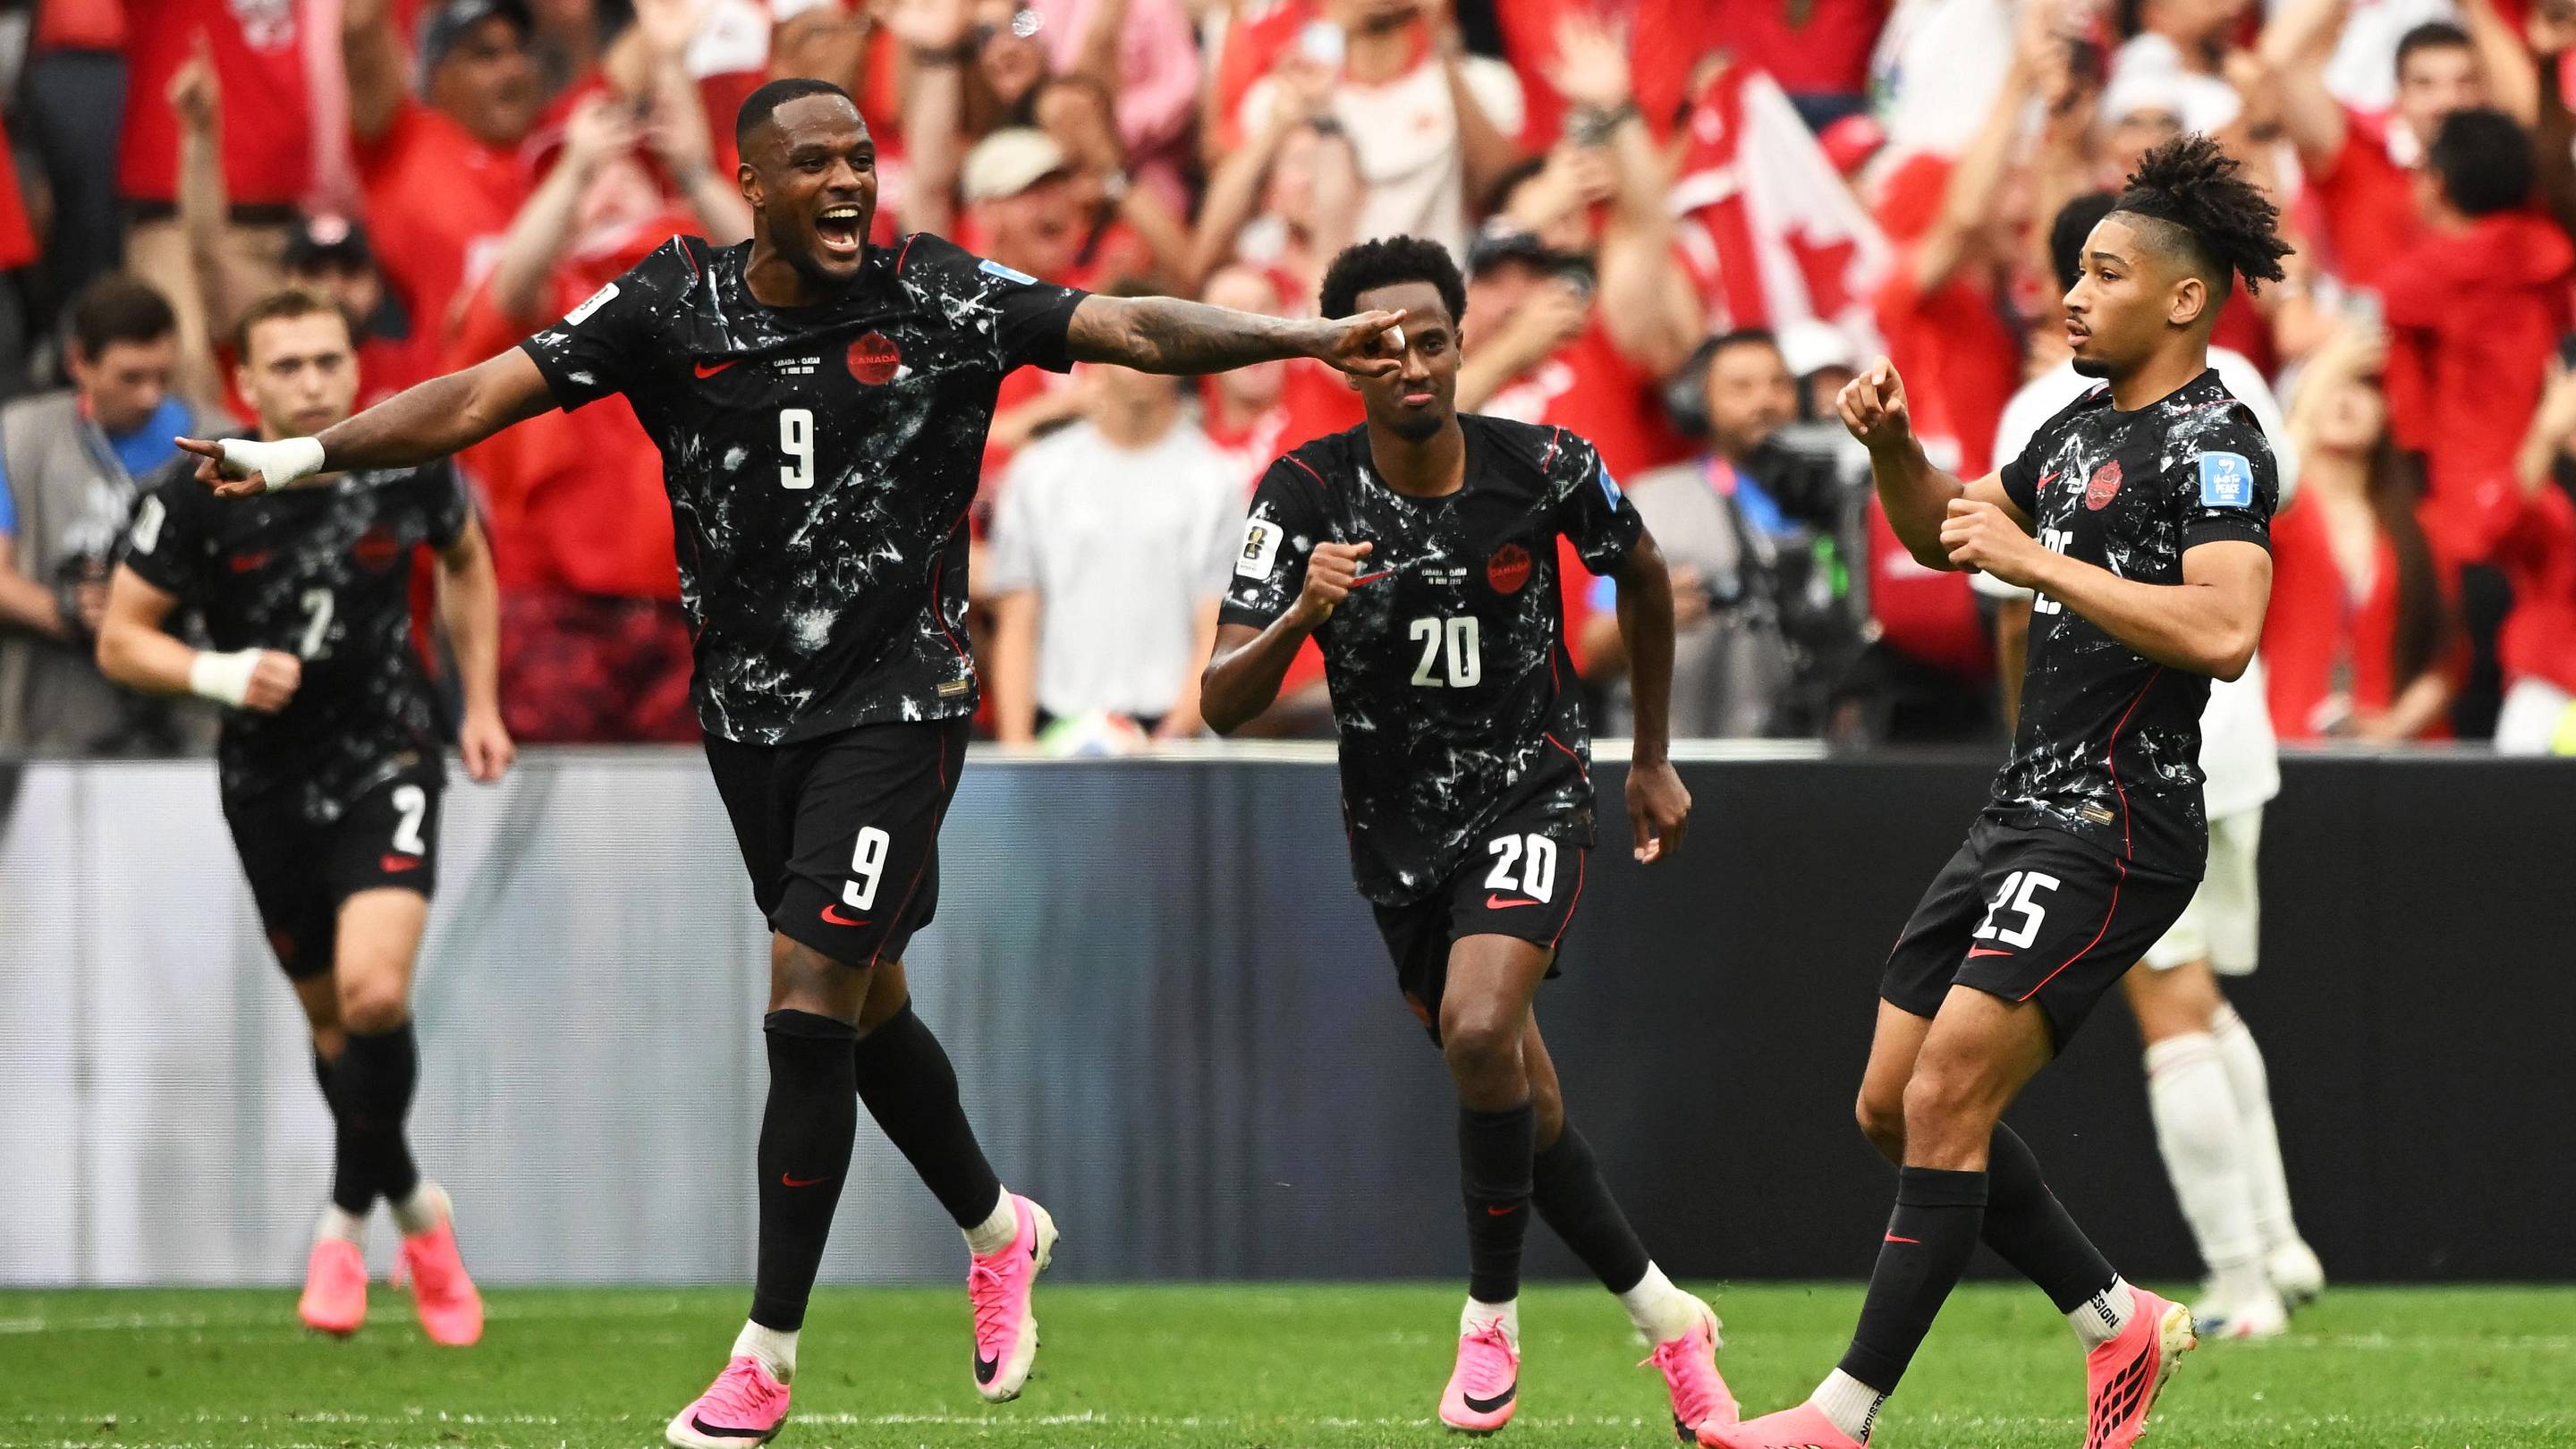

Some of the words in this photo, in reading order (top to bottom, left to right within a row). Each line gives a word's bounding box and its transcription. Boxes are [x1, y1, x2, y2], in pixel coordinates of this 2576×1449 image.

[850, 354, 897, 365] CANADA
[780, 409, 814, 489] 9
[300, 588, 335, 660] 2
[1410, 615, 1481, 688] 20
[392, 784, 426, 856] 2
[843, 826, 890, 911] 9
[1485, 833, 1557, 904] 20
[1972, 870, 2061, 949] 25
[2090, 1290, 2120, 1329] ESIGN
[1860, 1394, 1885, 1437] DESIGN
